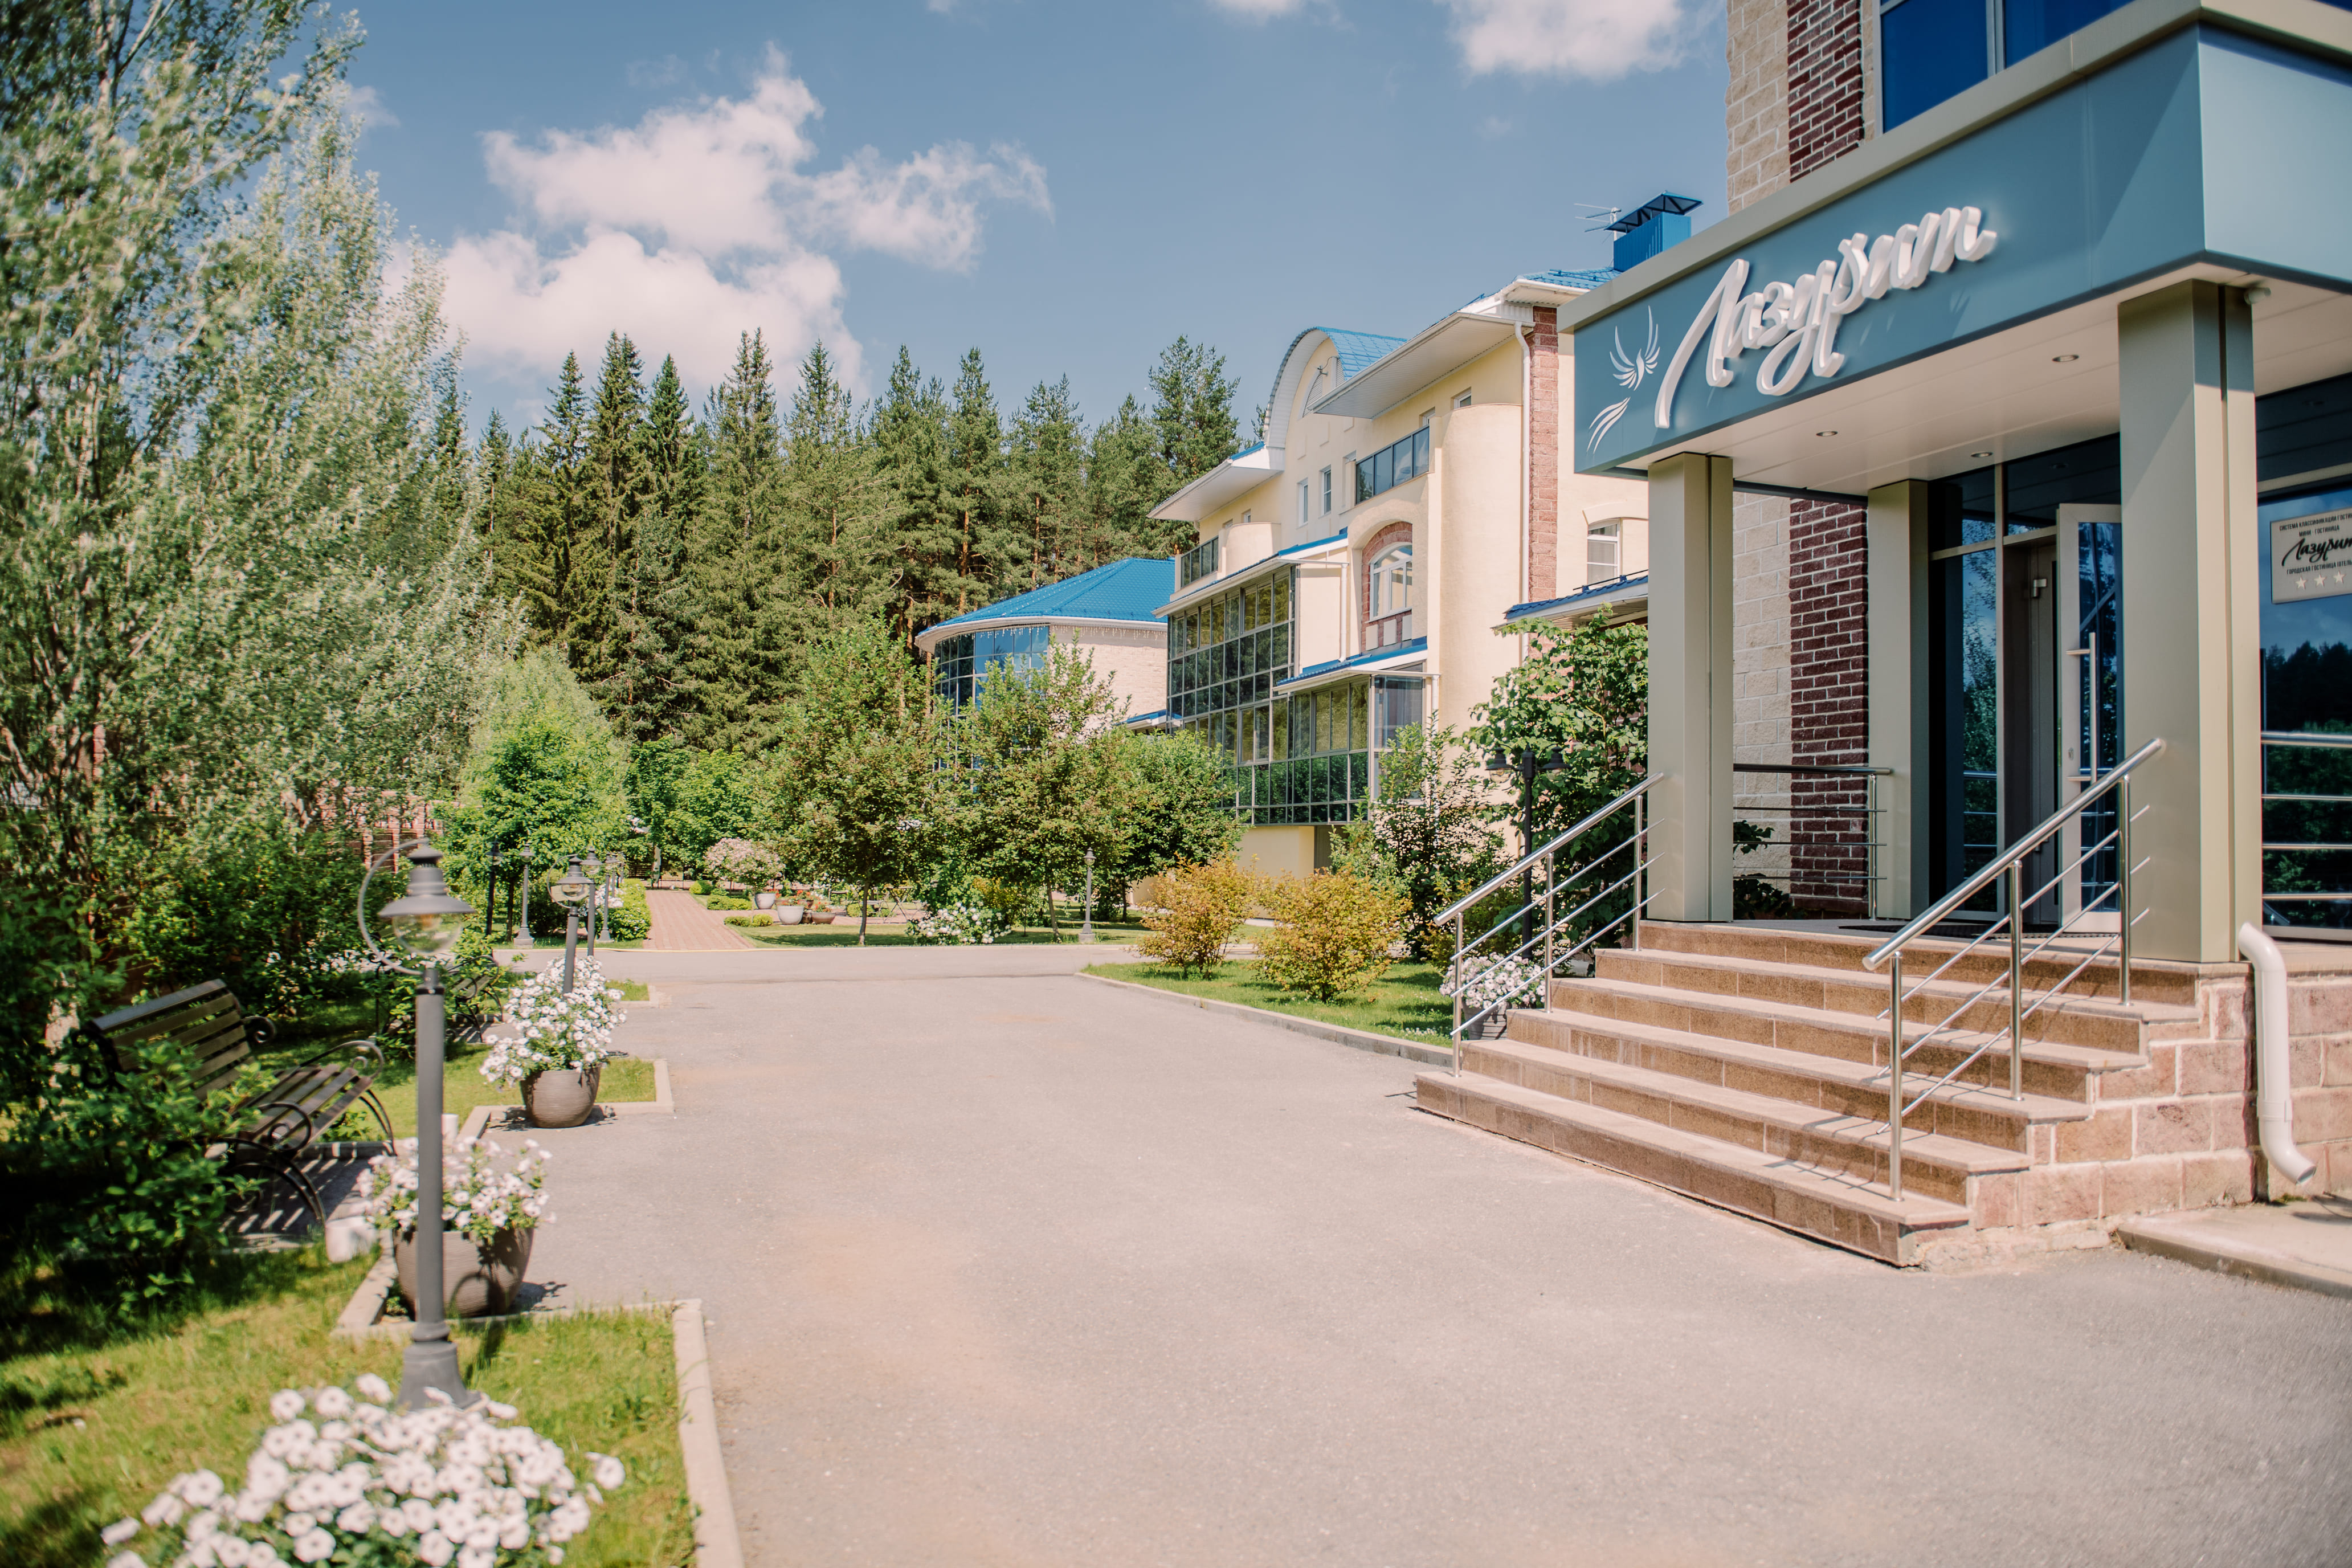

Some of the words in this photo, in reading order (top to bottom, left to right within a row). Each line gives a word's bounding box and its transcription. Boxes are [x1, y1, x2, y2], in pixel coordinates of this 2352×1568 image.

[1655, 206, 1997, 428] Лазурит
[2279, 522, 2298, 531] СИСТЕМА
[2299, 516, 2337, 527] КЛАССИФИКАЦИИ
[2314, 525, 2339, 534] ГОСТИНИЦА
[2312, 562, 2336, 571] ГОСТИНИЦА
